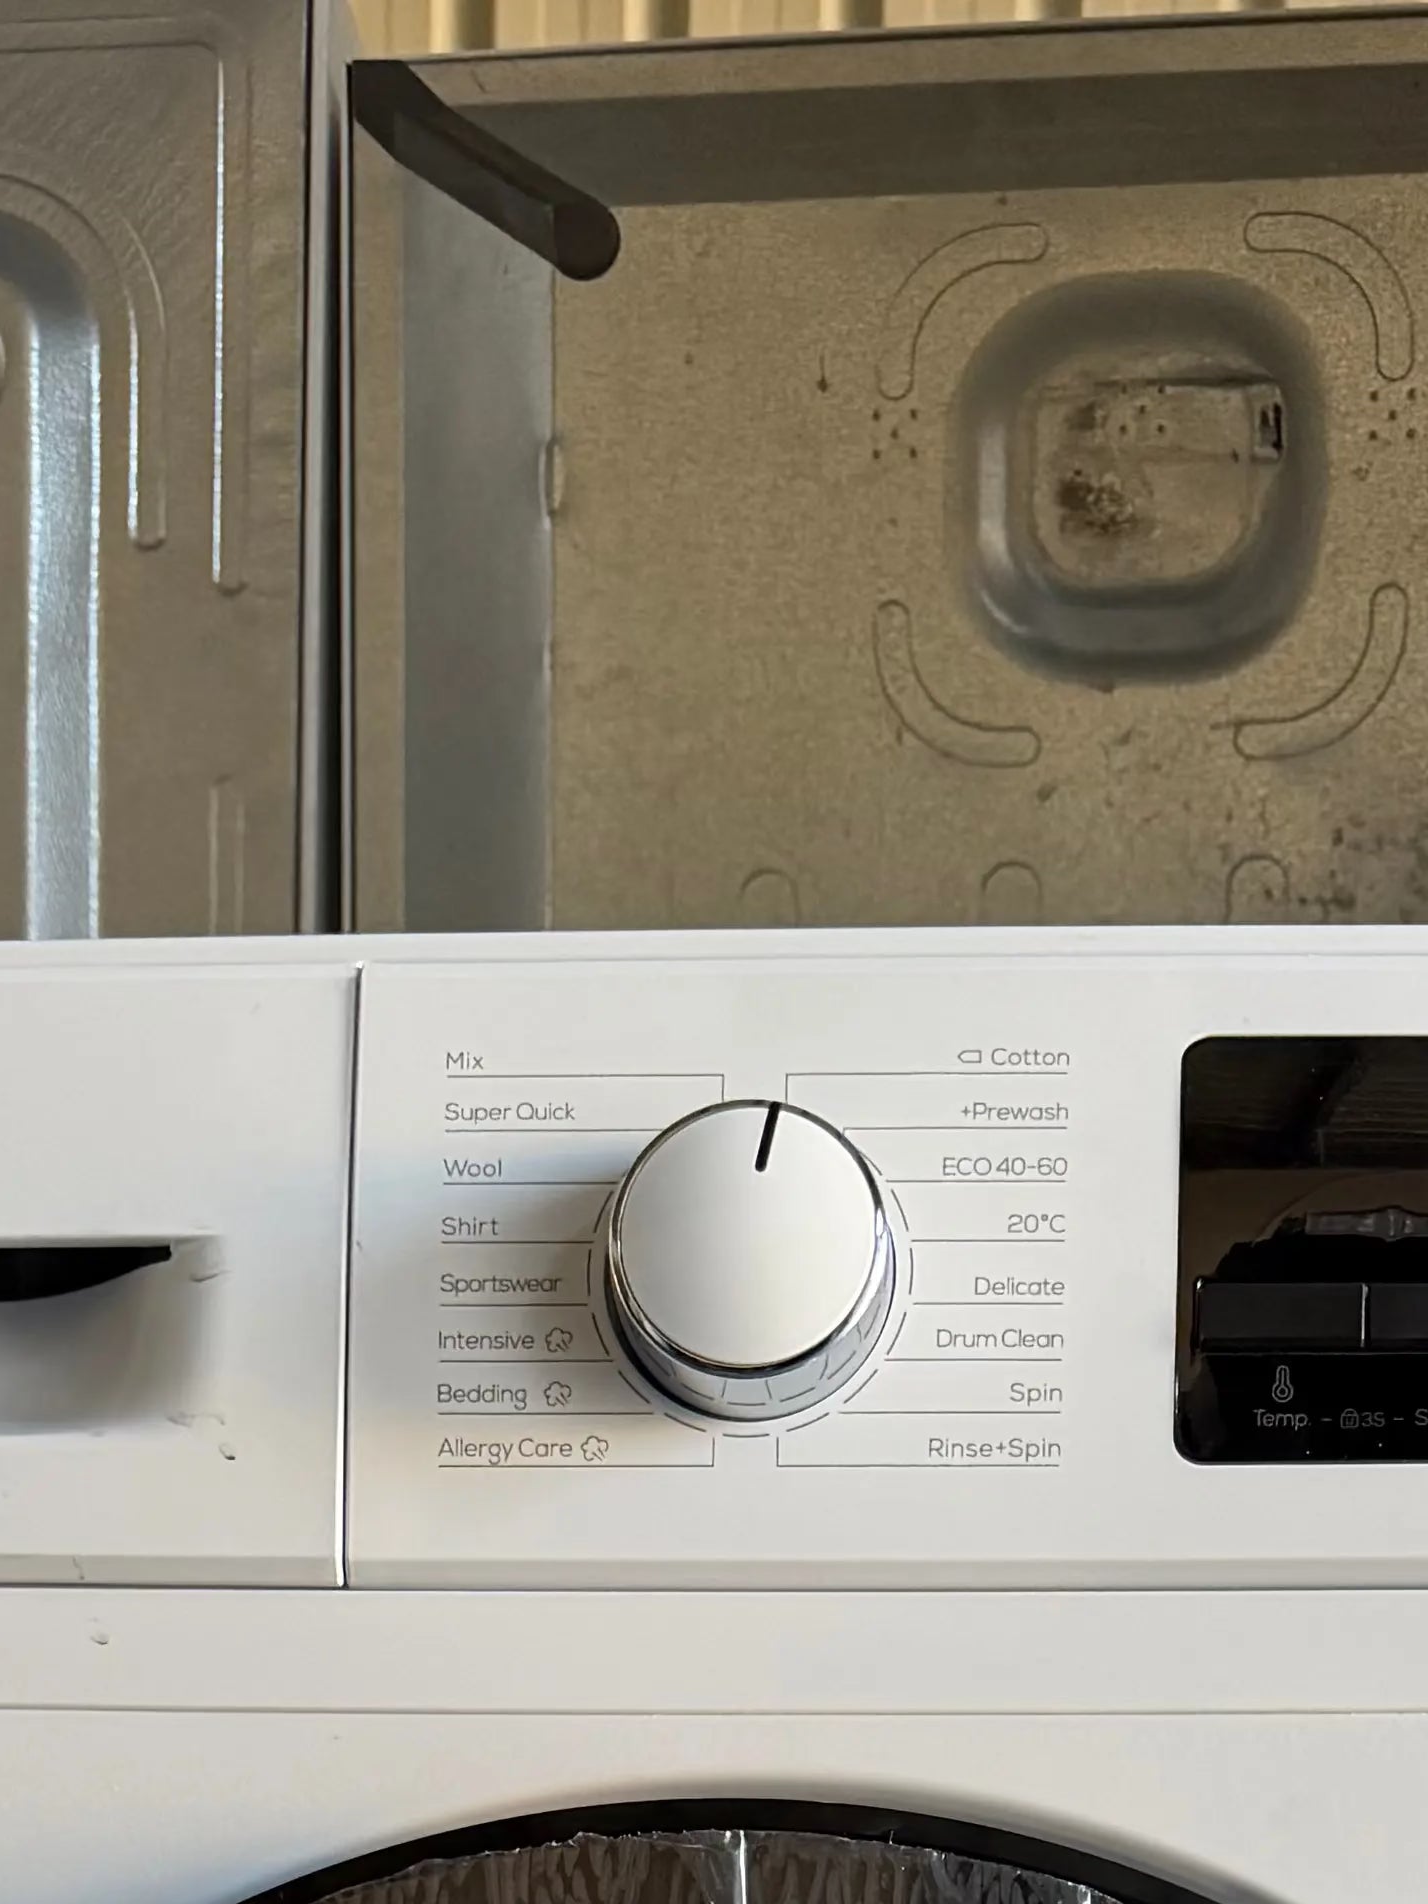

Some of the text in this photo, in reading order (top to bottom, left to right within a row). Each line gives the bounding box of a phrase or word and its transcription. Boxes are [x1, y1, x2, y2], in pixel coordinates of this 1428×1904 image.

[446, 1052, 484, 1070] Mix
[991, 1048, 1070, 1066] Cotton
[445, 1102, 575, 1125] Super Quick
[961, 1103, 1068, 1121] +Prewash
[443, 1158, 502, 1178] Wool
[943, 1156, 1068, 1176] ECO 40-60
[441, 1217, 498, 1236] Shirt
[1007, 1214, 1065, 1233] 20°C
[440, 1273, 564, 1296] Sportswear
[974, 1277, 1065, 1296] Delicate
[438, 1330, 535, 1350] Intensive
[936, 1329, 1063, 1348] Drum Clean
[437, 1384, 527, 1410] Bedding
[1010, 1383, 1062, 1406] Spin
[438, 1438, 572, 1465] Allergy Care
[929, 1437, 1060, 1462] Rinse+Spin
